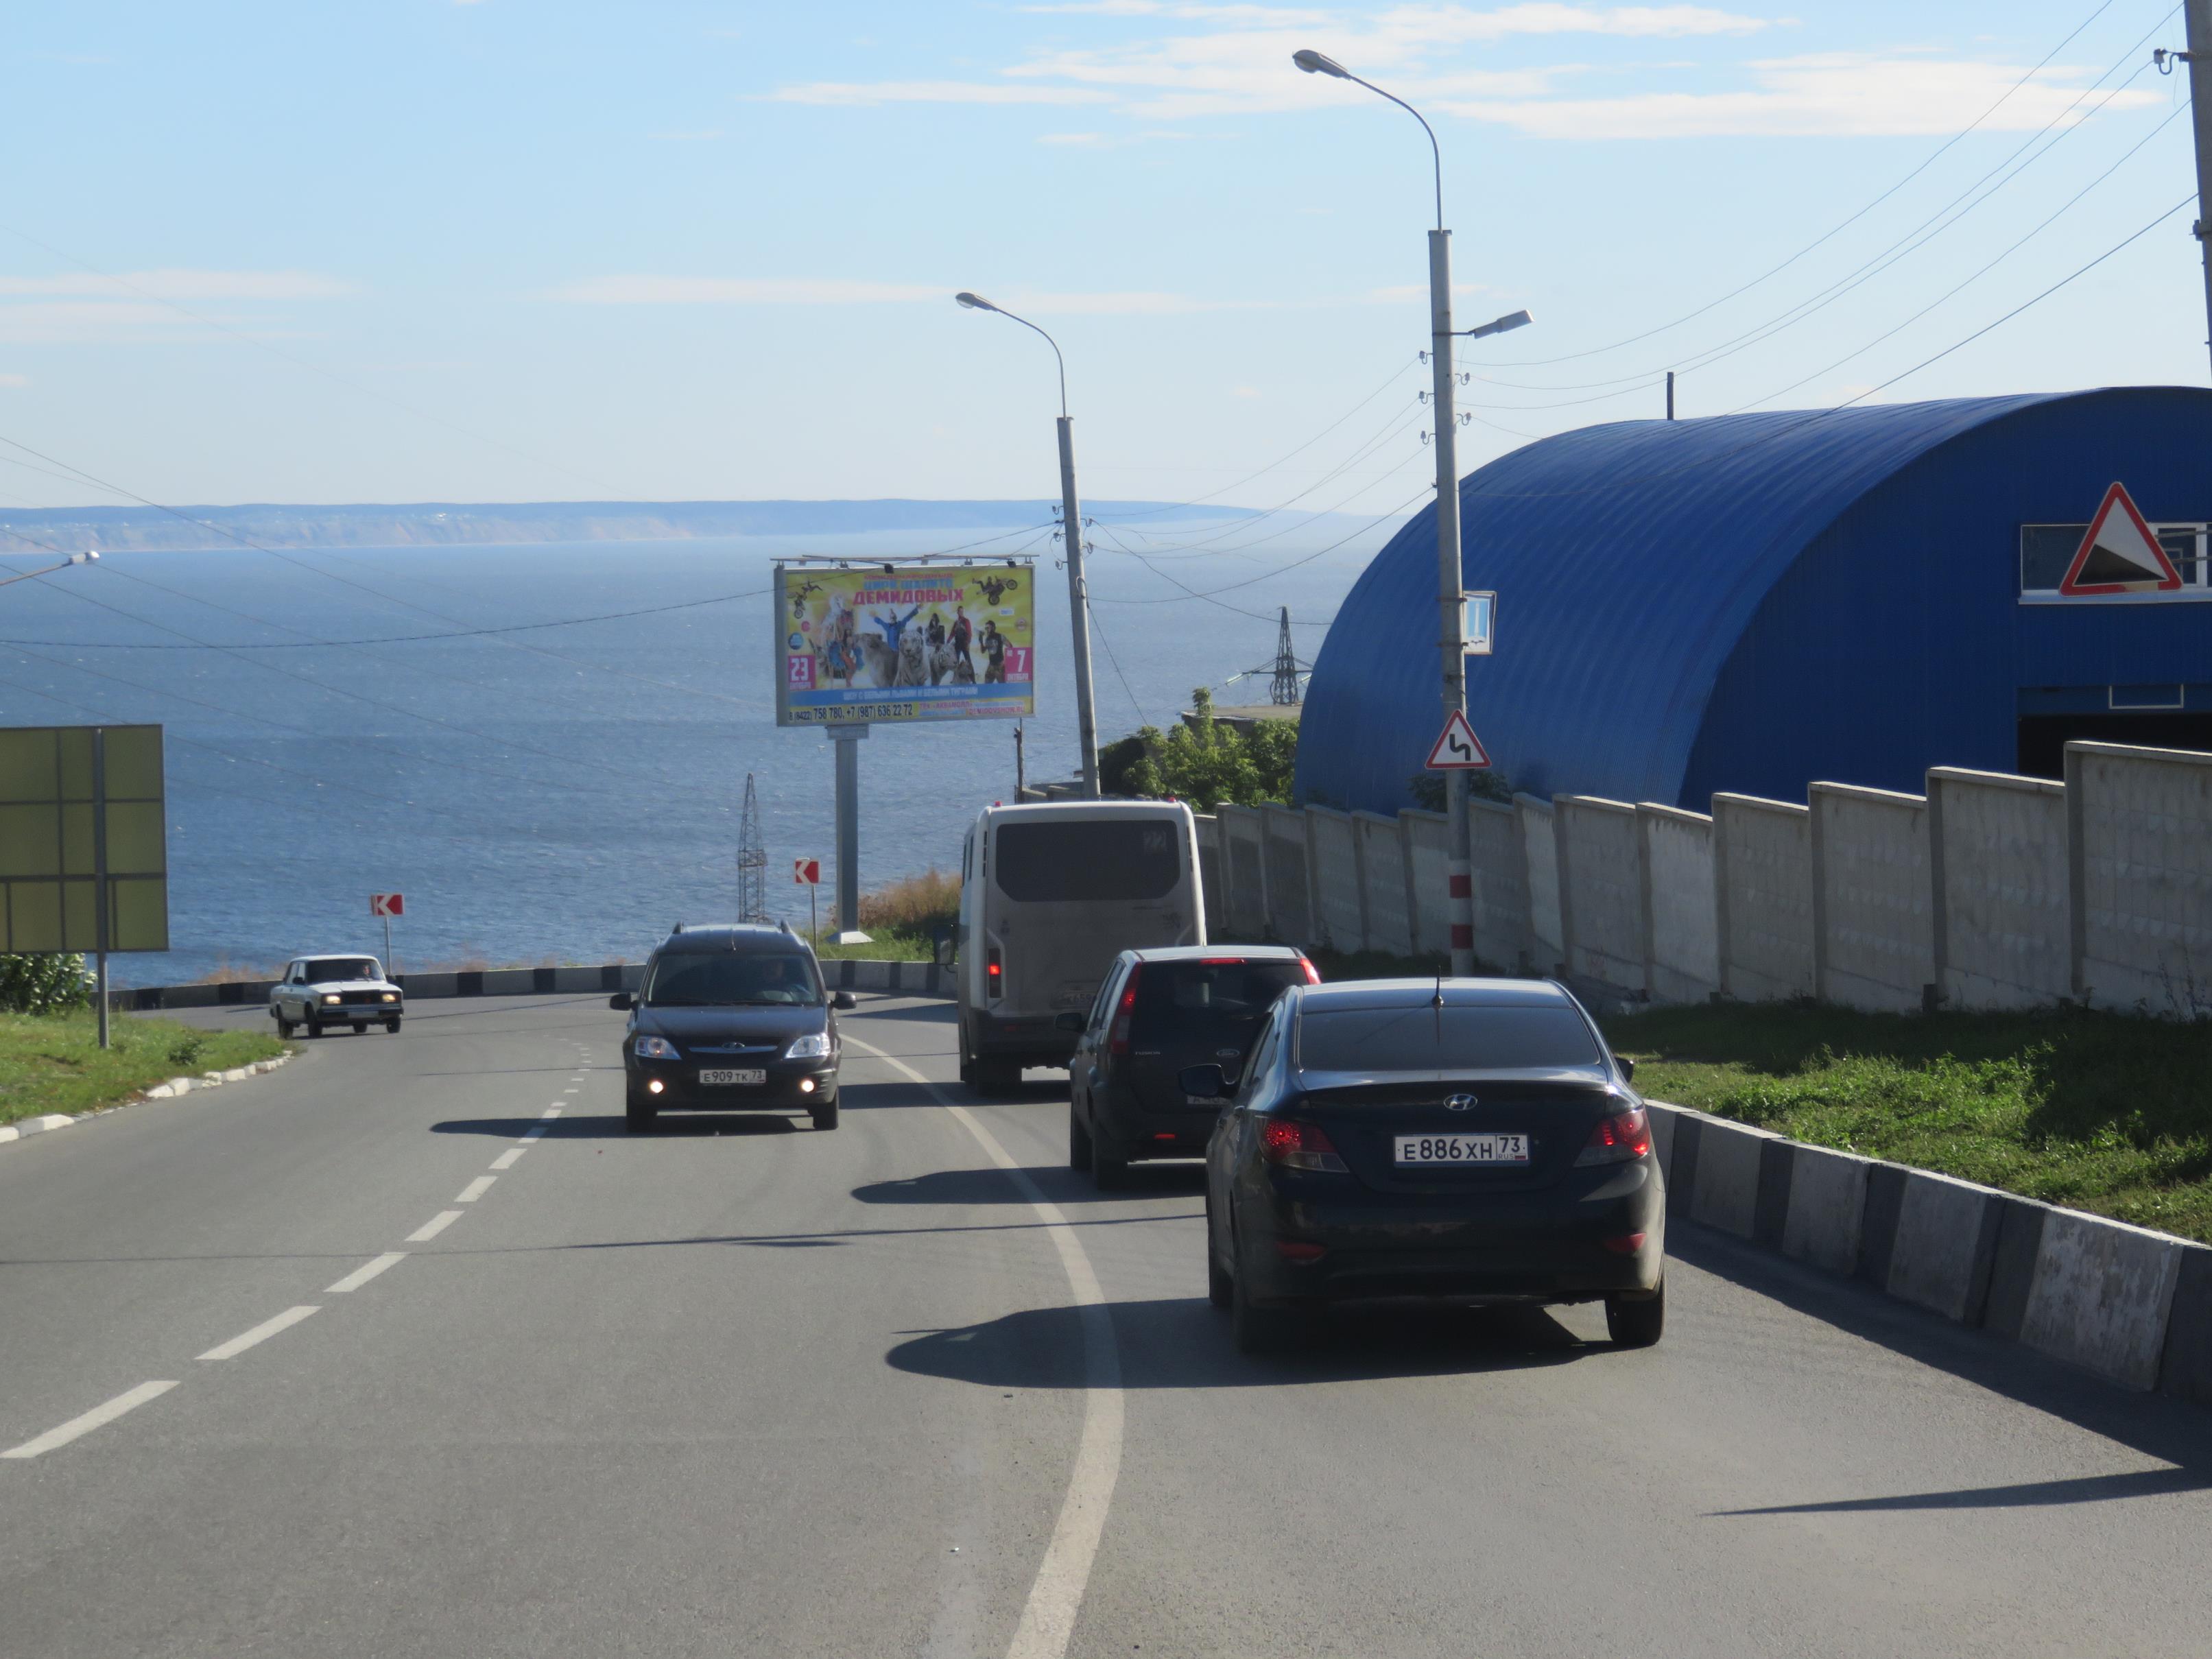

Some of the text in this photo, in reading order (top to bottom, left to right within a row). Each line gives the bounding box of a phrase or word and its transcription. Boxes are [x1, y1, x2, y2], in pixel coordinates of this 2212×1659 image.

[853, 588, 964, 606] ДЕМИДОВЫХ
[791, 658, 809, 681] 23
[1018, 649, 1026, 672] 7
[813, 708, 827, 719] 758
[829, 707, 845, 719] 780,
[846, 706, 855, 718] +7
[857, 706, 876, 719] (987)
[877, 705, 891, 717] 636
[893, 704, 902, 716] 22
[903, 704, 913, 716] 72
[704, 1070, 762, 1082] Е909ТК 73
[1404, 1136, 1521, 1160] Е886ХН 73
